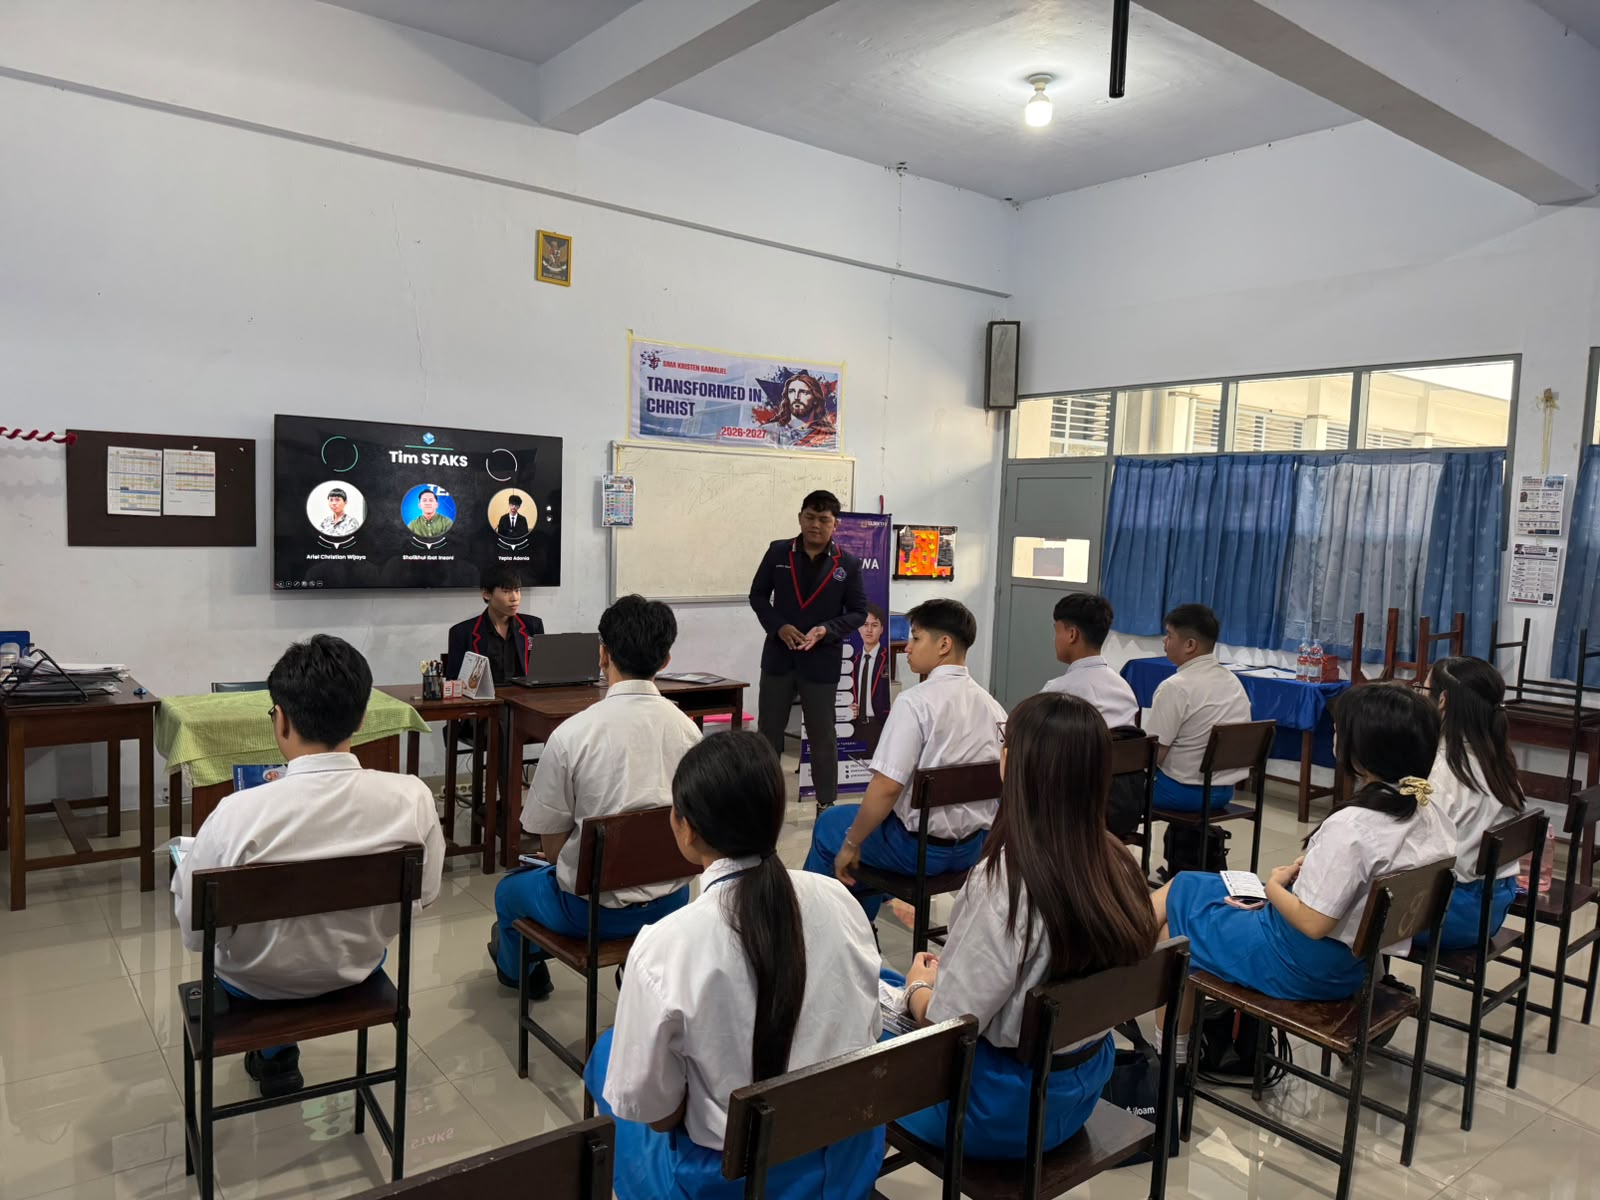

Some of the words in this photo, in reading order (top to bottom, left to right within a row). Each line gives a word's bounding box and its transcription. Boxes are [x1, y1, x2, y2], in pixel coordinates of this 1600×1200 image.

[662, 360, 676, 369] SMA
[677, 362, 700, 371] KRISTEN
[647, 376, 746, 401] TRANSFORMED
[748, 387, 762, 403] IN
[646, 398, 696, 417] CHRIST
[721, 426, 768, 439] 2026-2027
[389, 450, 419, 465] Tim
[421, 452, 469, 467] STAKS
